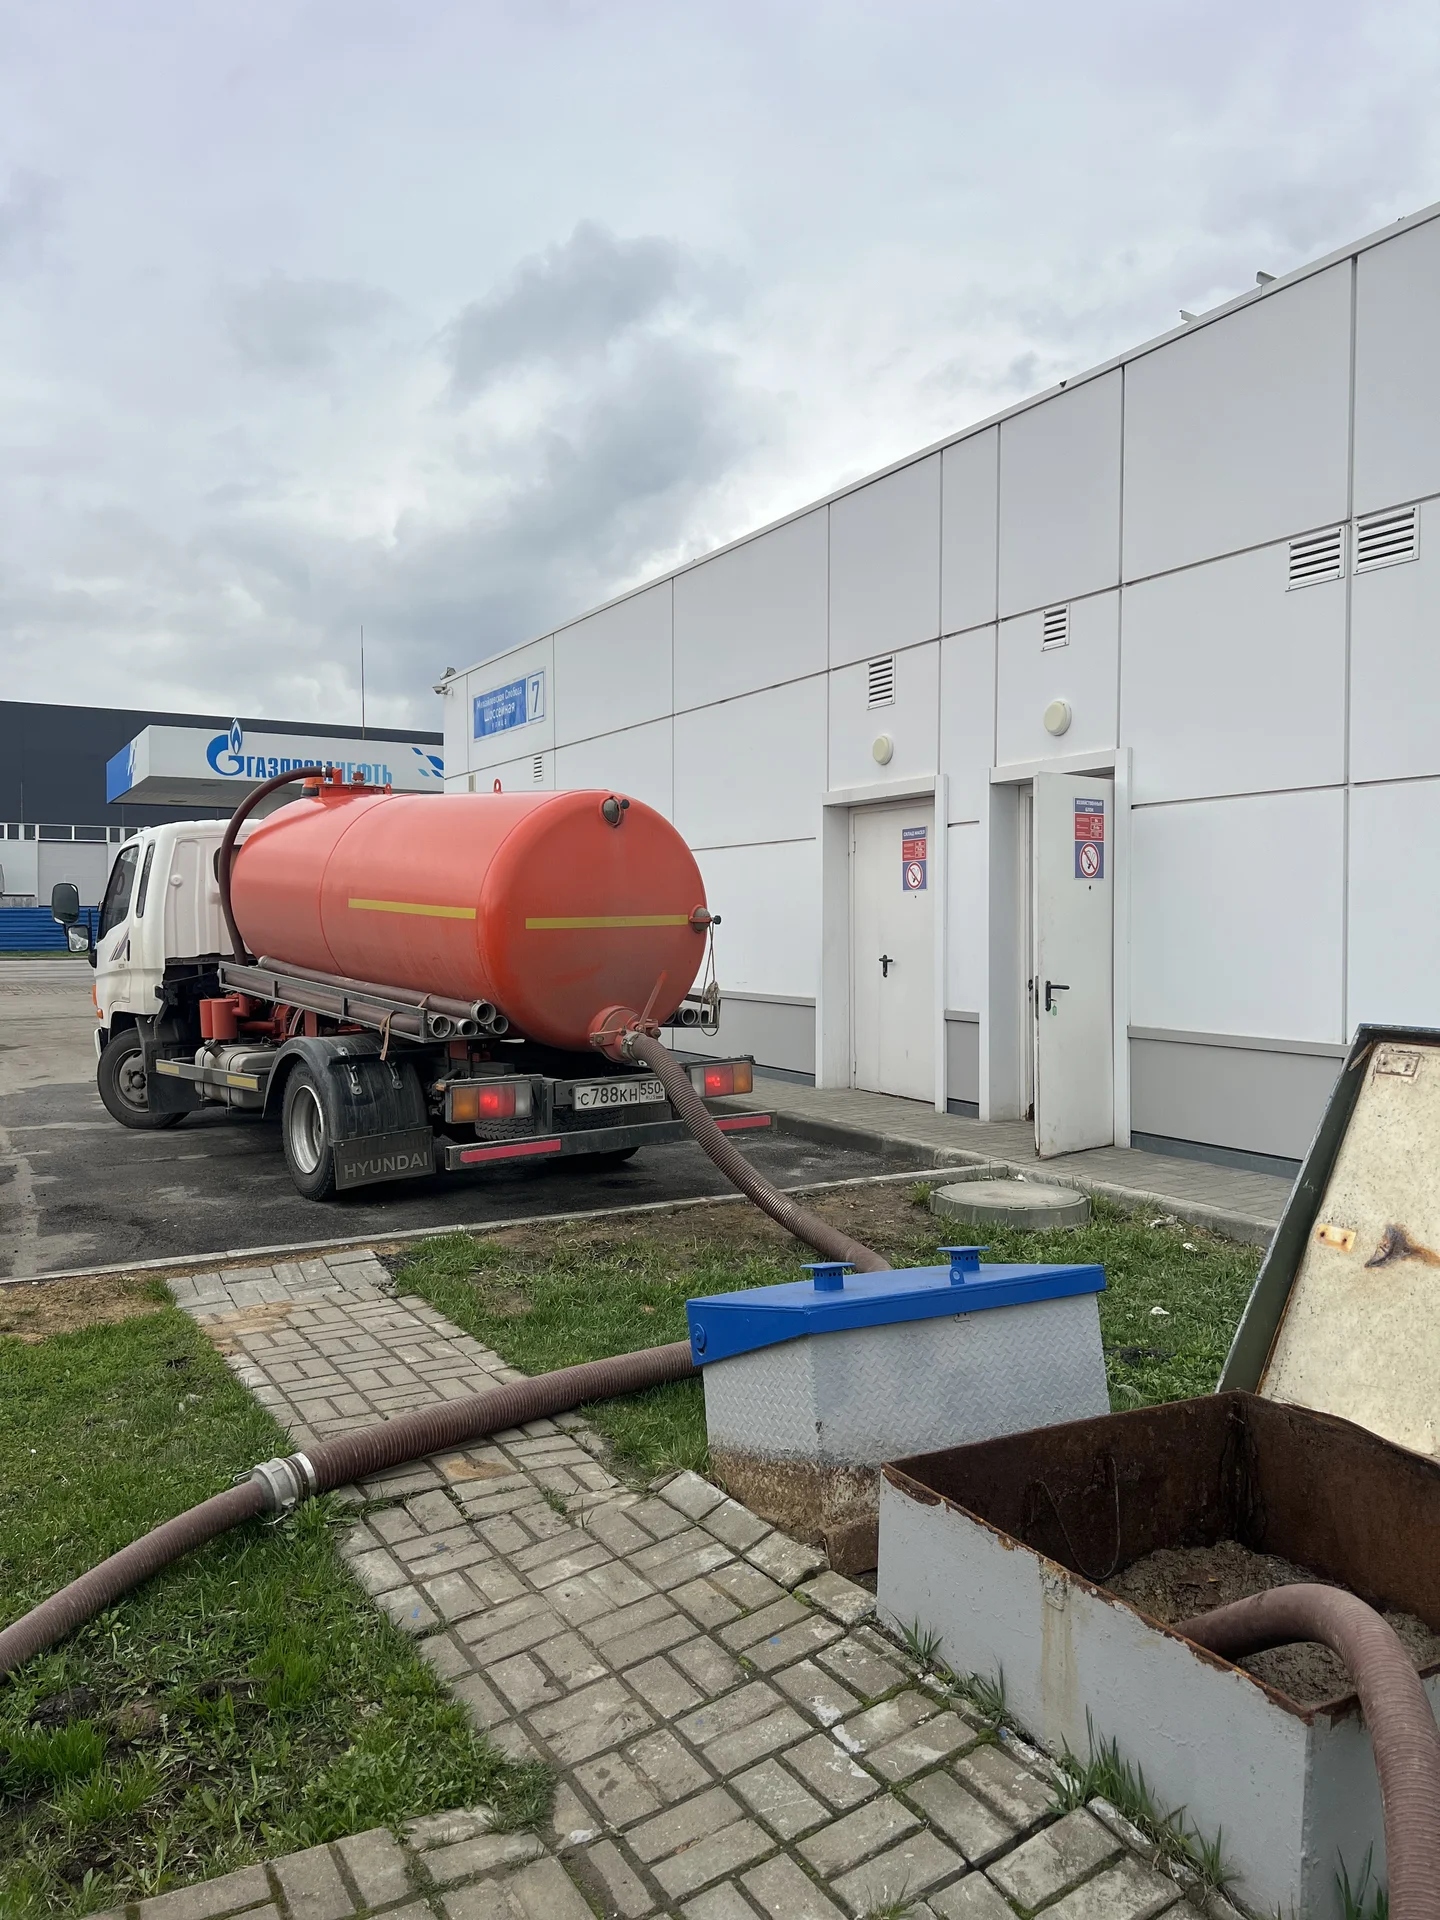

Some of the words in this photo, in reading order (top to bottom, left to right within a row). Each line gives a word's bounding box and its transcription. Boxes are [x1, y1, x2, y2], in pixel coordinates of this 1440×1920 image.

[532, 680, 539, 713] 7
[483, 701, 516, 722] Шоссейная
[640, 1081, 661, 1096] 550
[344, 1151, 428, 1180] HYUNDAI
